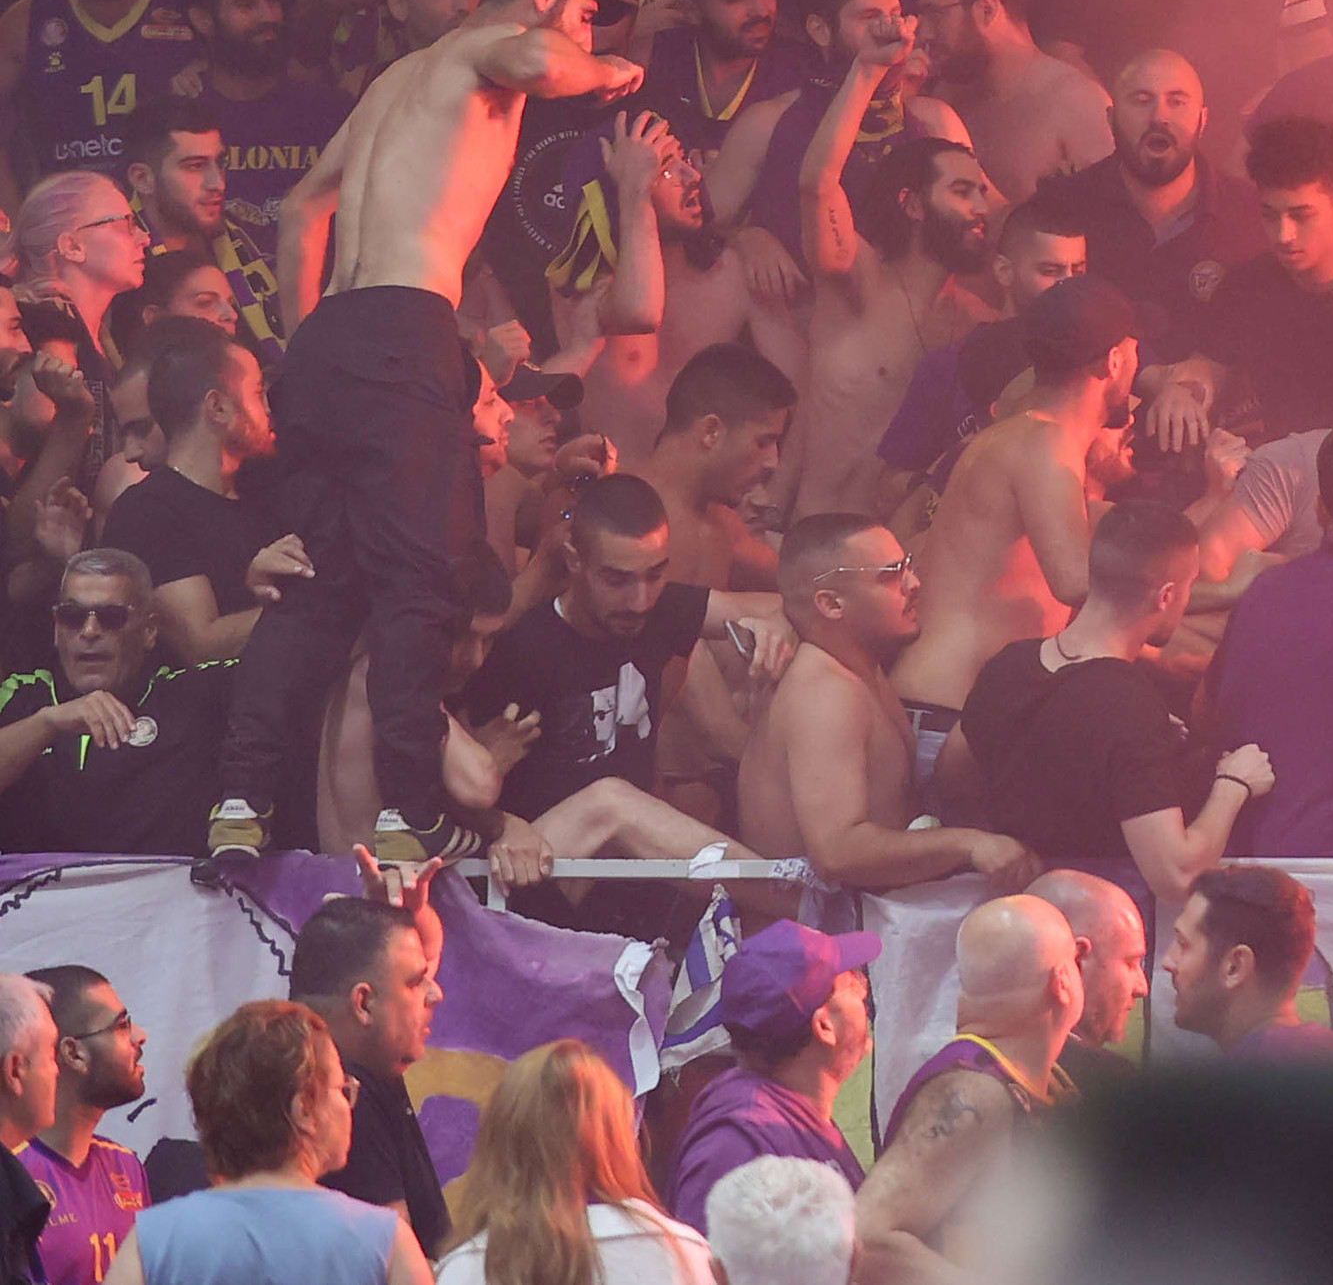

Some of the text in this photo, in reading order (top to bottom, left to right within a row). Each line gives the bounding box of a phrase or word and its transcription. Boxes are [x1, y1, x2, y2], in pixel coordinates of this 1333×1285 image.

[80, 72, 137, 126] 14
[226, 145, 319, 171] LONIA
[89, 1232, 117, 1284] 11
